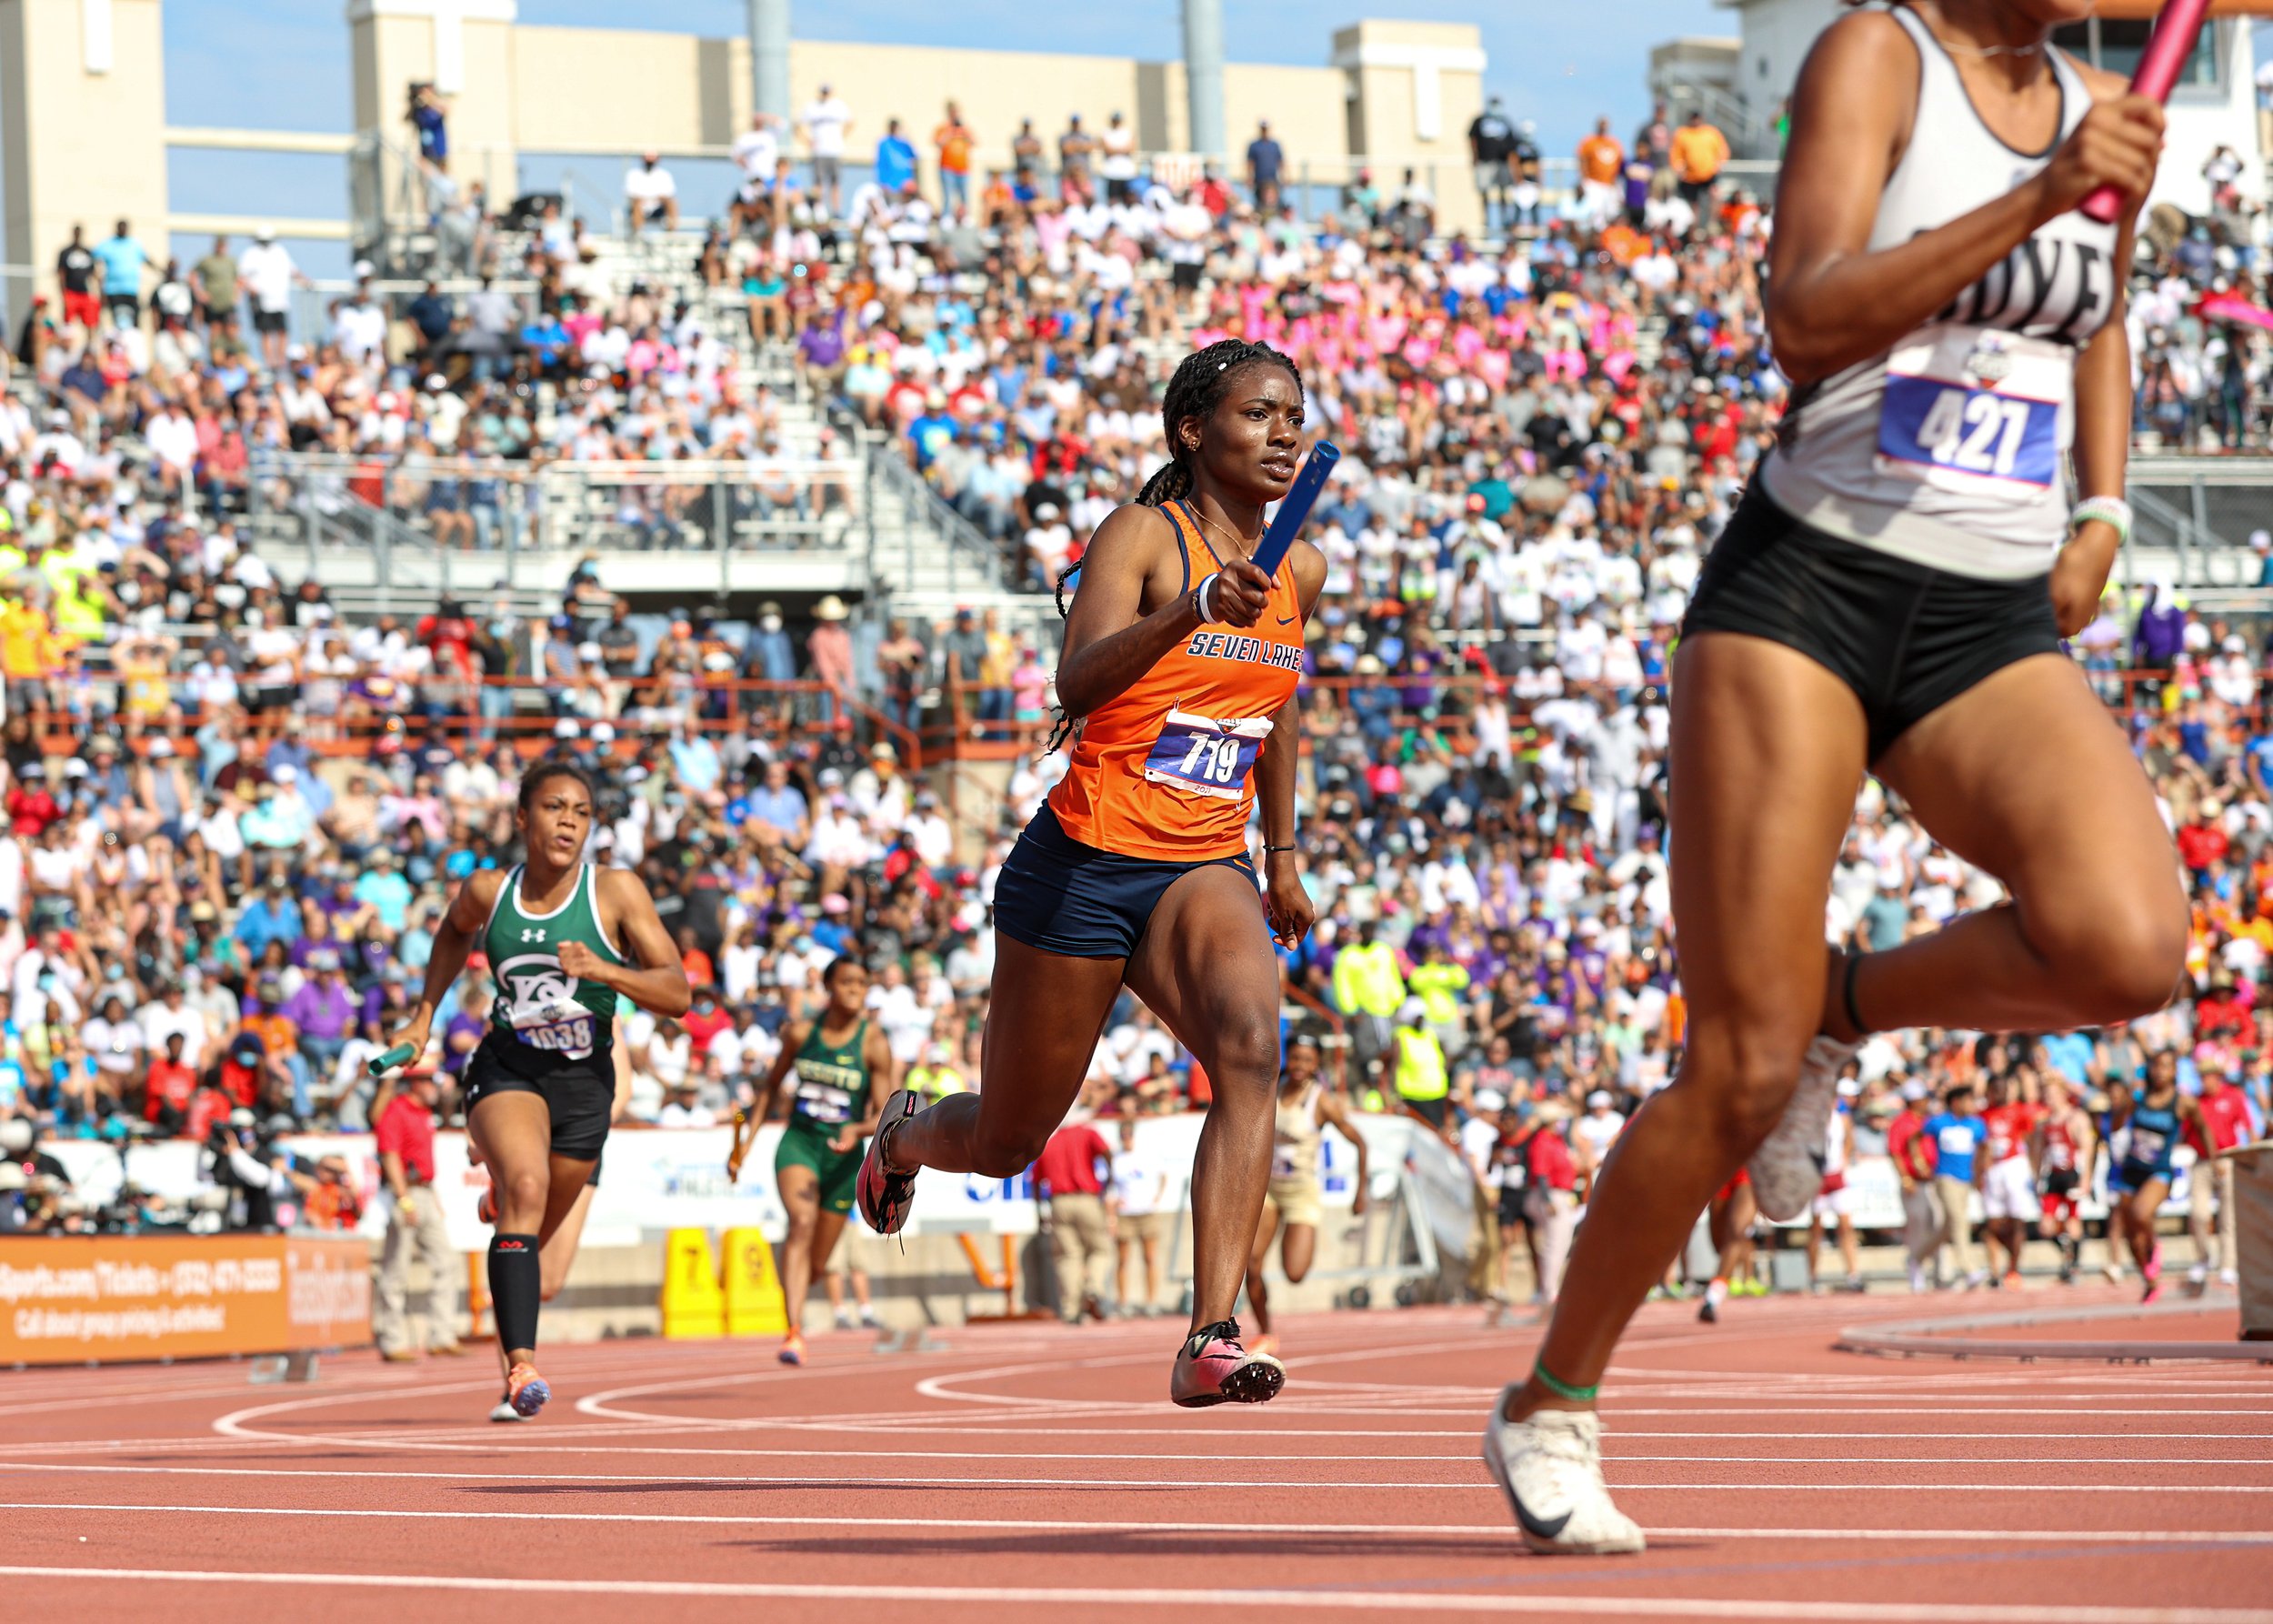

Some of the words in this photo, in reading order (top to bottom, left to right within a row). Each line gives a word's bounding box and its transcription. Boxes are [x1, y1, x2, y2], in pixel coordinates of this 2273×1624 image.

[1917, 388, 2030, 476] 421
[1186, 631, 1261, 663] SEVEN
[525, 1018, 592, 1050] 1038
